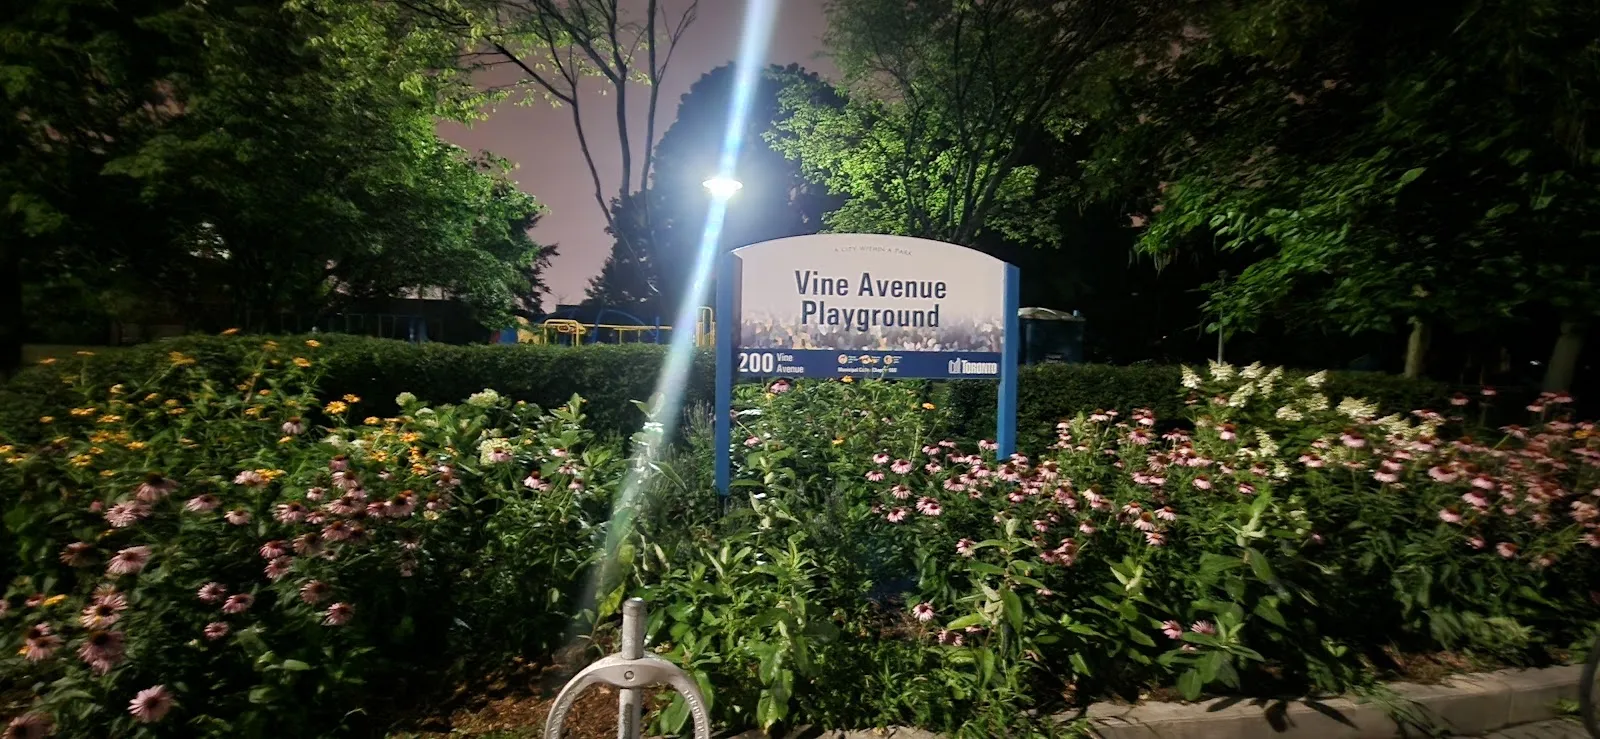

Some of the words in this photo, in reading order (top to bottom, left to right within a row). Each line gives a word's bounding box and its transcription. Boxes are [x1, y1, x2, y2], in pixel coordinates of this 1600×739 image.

[894, 248, 912, 256] PARK
[795, 270, 849, 296] Vine
[858, 272, 947, 298] Avenue
[801, 300, 940, 332] Playground
[739, 353, 773, 373] 200
[776, 353, 793, 362] Vine
[776, 364, 804, 373] Avenue
[961, 360, 998, 374] TORONTO
